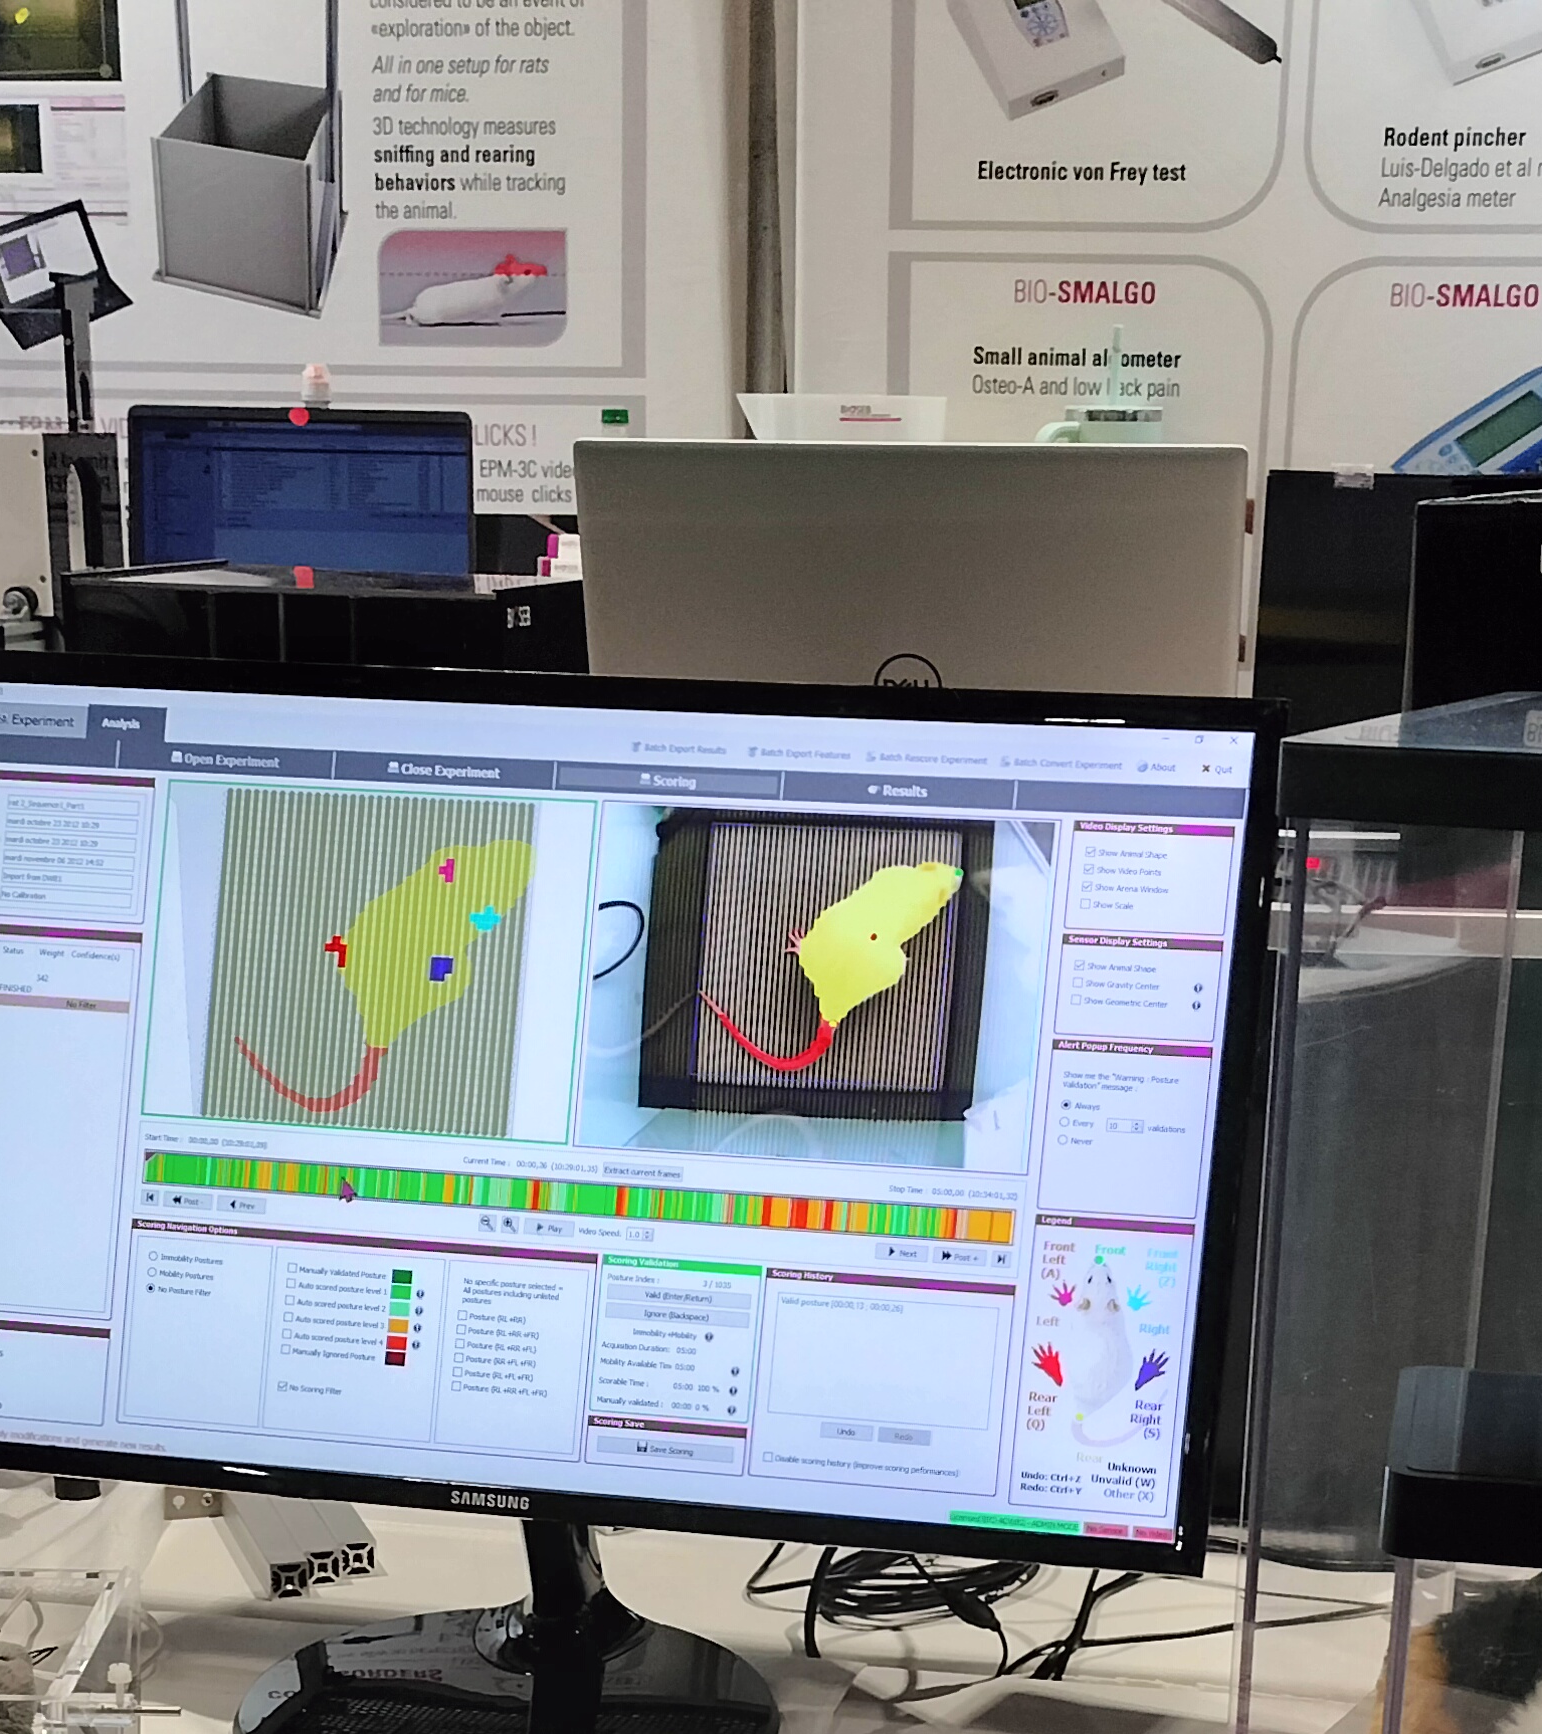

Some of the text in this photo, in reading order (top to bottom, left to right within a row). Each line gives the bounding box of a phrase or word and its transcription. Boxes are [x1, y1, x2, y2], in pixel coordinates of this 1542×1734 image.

[475, 18, 491, 37] of
[496, 18, 520, 37] the
[372, 54, 550, 77] All in one setup for rats
[373, 84, 401, 103] and
[405, 84, 428, 103] for
[372, 116, 557, 139] 3D technology measures
[1383, 127, 1526, 152] Rodent pincher
[374, 145, 536, 167] sniffing and rearing
[978, 160, 1186, 185] Electronic von Frey test
[1381, 157, 1489, 182] Luis-Delgado
[1495, 160, 1512, 178] et
[1517, 157, 1532, 178] al
[375, 173, 566, 196] behaviors while tracking
[1378, 187, 1517, 212] Analgesia meter
[375, 201, 399, 220] the
[1014, 278, 1156, 304] BIO-SMALGO
[1389, 282, 1539, 308] BIO-SMALGO
[973, 346, 1182, 368] Small animal alometer
[972, 373, 1035, 395] Osteo-A
[1039, 376, 1068, 396] and
[1073, 377, 1102, 396] low
[1147, 378, 1180, 401] pain
[474, 423, 527, 447] LICKS
[479, 460, 575, 479] EPM-3C vide
[477, 486, 572, 503] mouse clicks
[11, 713, 76, 729] Experiment
[101, 716, 141, 731] Analysis
[184, 752, 280, 770] Open Experiment
[1150, 761, 1176, 774] About
[401, 763, 500, 782] Close Experiment
[653, 775, 697, 791] Scoring
[882, 784, 928, 799] Results
[1080, 822, 1173, 834] Video Display Settings
[1068, 935, 1168, 948] Sensor Display Settings
[1029, 1391, 1058, 1403] Rear
[1134, 1400, 1163, 1412] Rear
[1027, 1405, 1051, 1417] Left
[1130, 1413, 1161, 1427] Right
[1107, 1462, 1157, 1475] Unknown
[1090, 1474, 1156, 1489] Unvalid (W)
[450, 1490, 530, 1510] SAMSUNG
